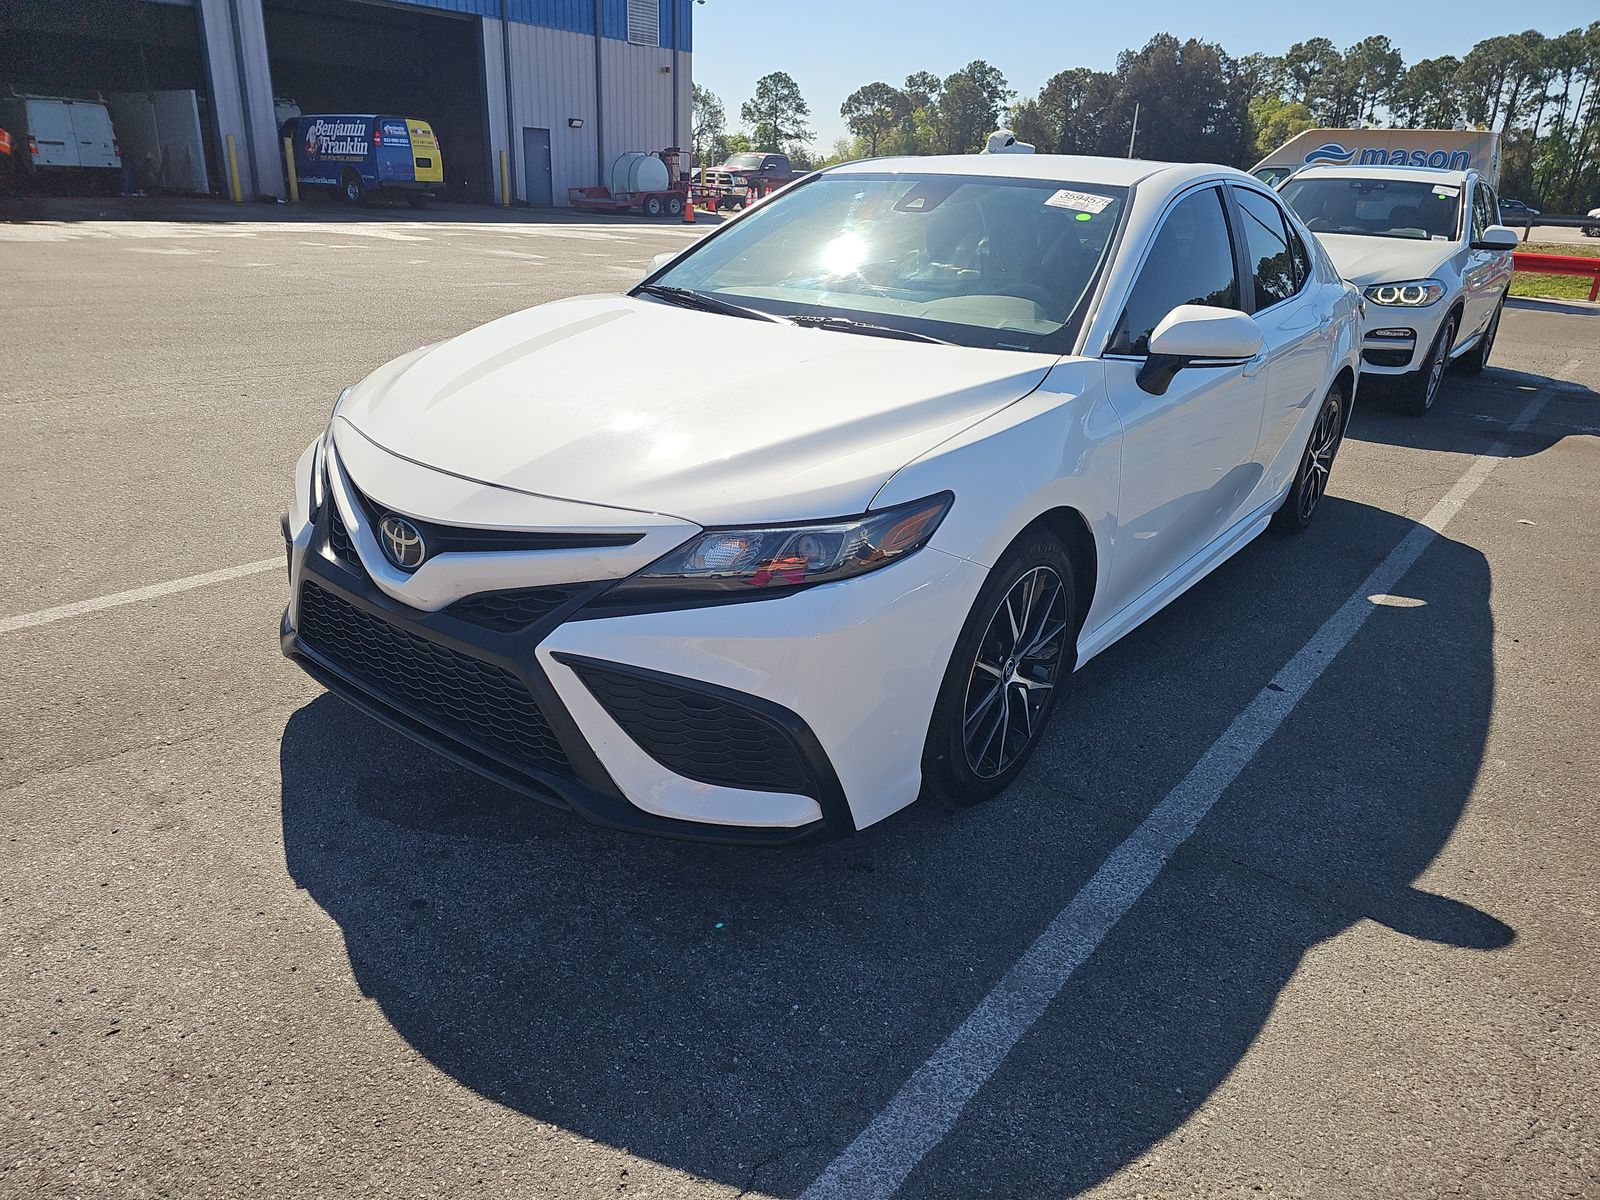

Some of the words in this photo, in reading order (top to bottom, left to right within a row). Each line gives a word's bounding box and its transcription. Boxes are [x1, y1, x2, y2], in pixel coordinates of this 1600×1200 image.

[316, 120, 366, 140] Benjamin
[318, 136, 368, 155] Franklin
[1359, 147, 1471, 171] mason
